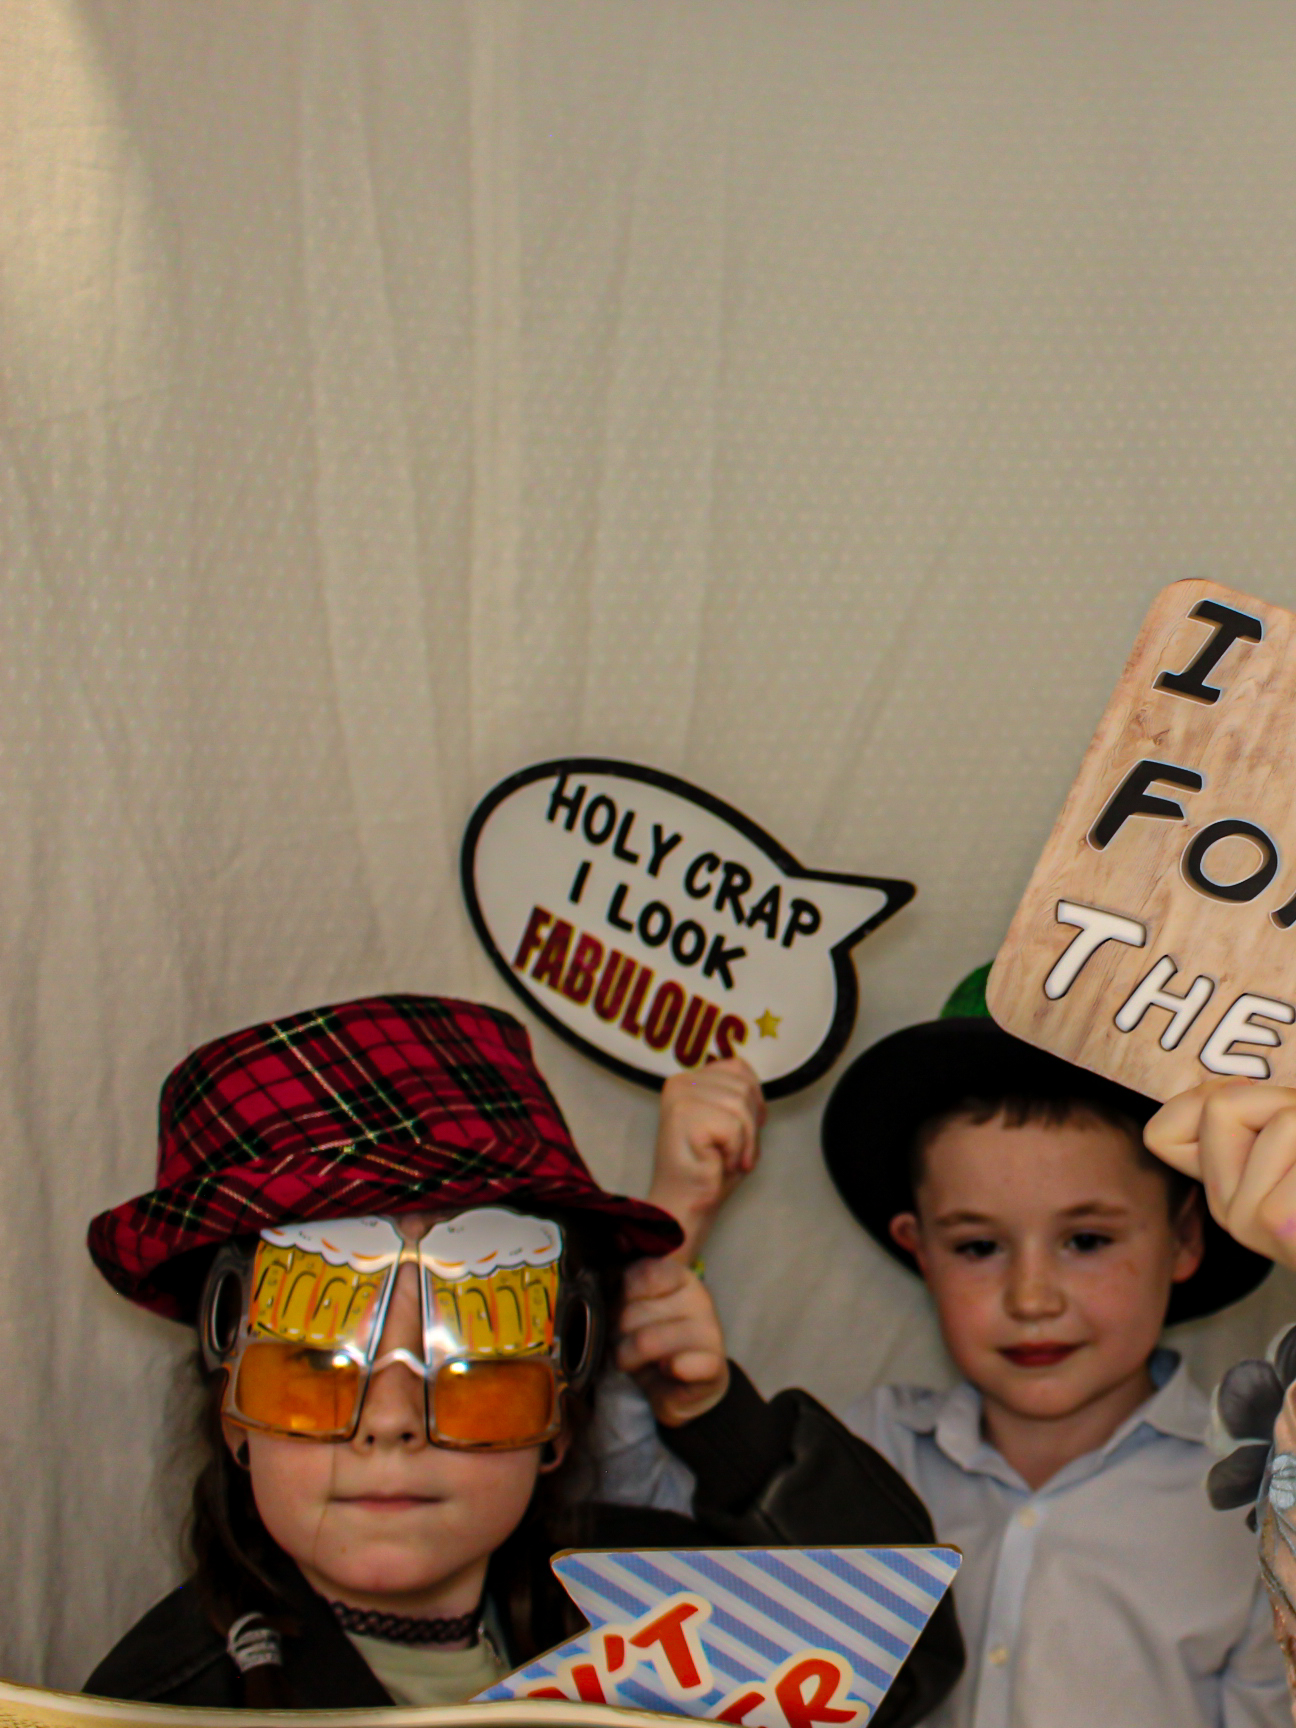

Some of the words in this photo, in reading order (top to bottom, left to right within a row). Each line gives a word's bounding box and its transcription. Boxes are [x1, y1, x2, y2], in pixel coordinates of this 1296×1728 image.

[1153, 599, 1263, 706] I
[547, 774, 682, 878] HOLY
[684, 852, 821, 948] CRAP
[569, 861, 592, 904] I
[607, 883, 747, 990] LOOK
[512, 905, 749, 1067] FABULOUS
[1043, 898, 1296, 1080] THE
